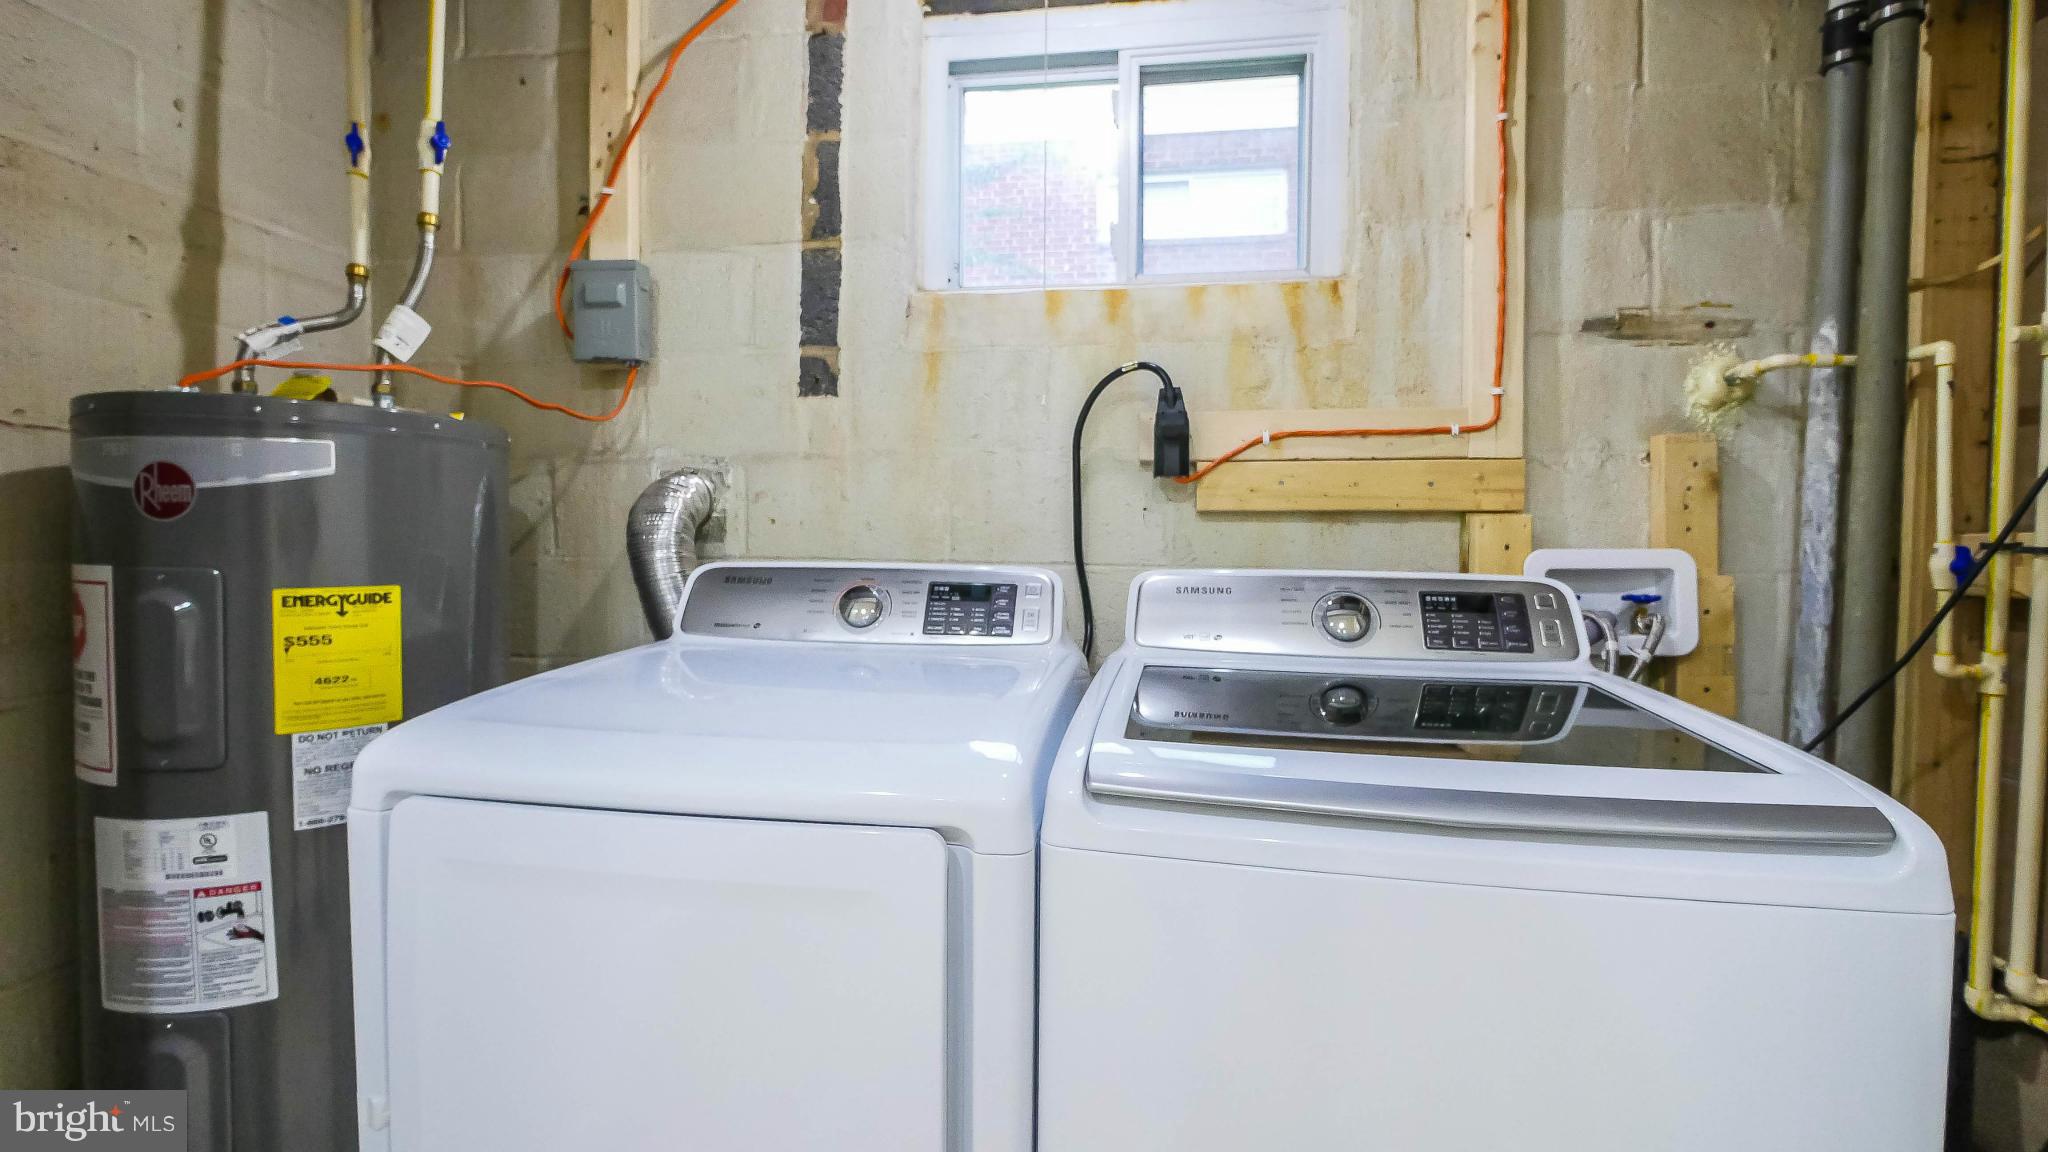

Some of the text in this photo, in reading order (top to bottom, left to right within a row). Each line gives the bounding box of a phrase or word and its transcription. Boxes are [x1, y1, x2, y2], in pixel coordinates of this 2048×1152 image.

[138, 462, 192, 511] Rheem
[1175, 586, 1233, 595] SAMSUNG
[283, 634, 333, 648] $555
[298, 726, 383, 743] DO NOT RETURN
[209, 885, 257, 896] DANGER
